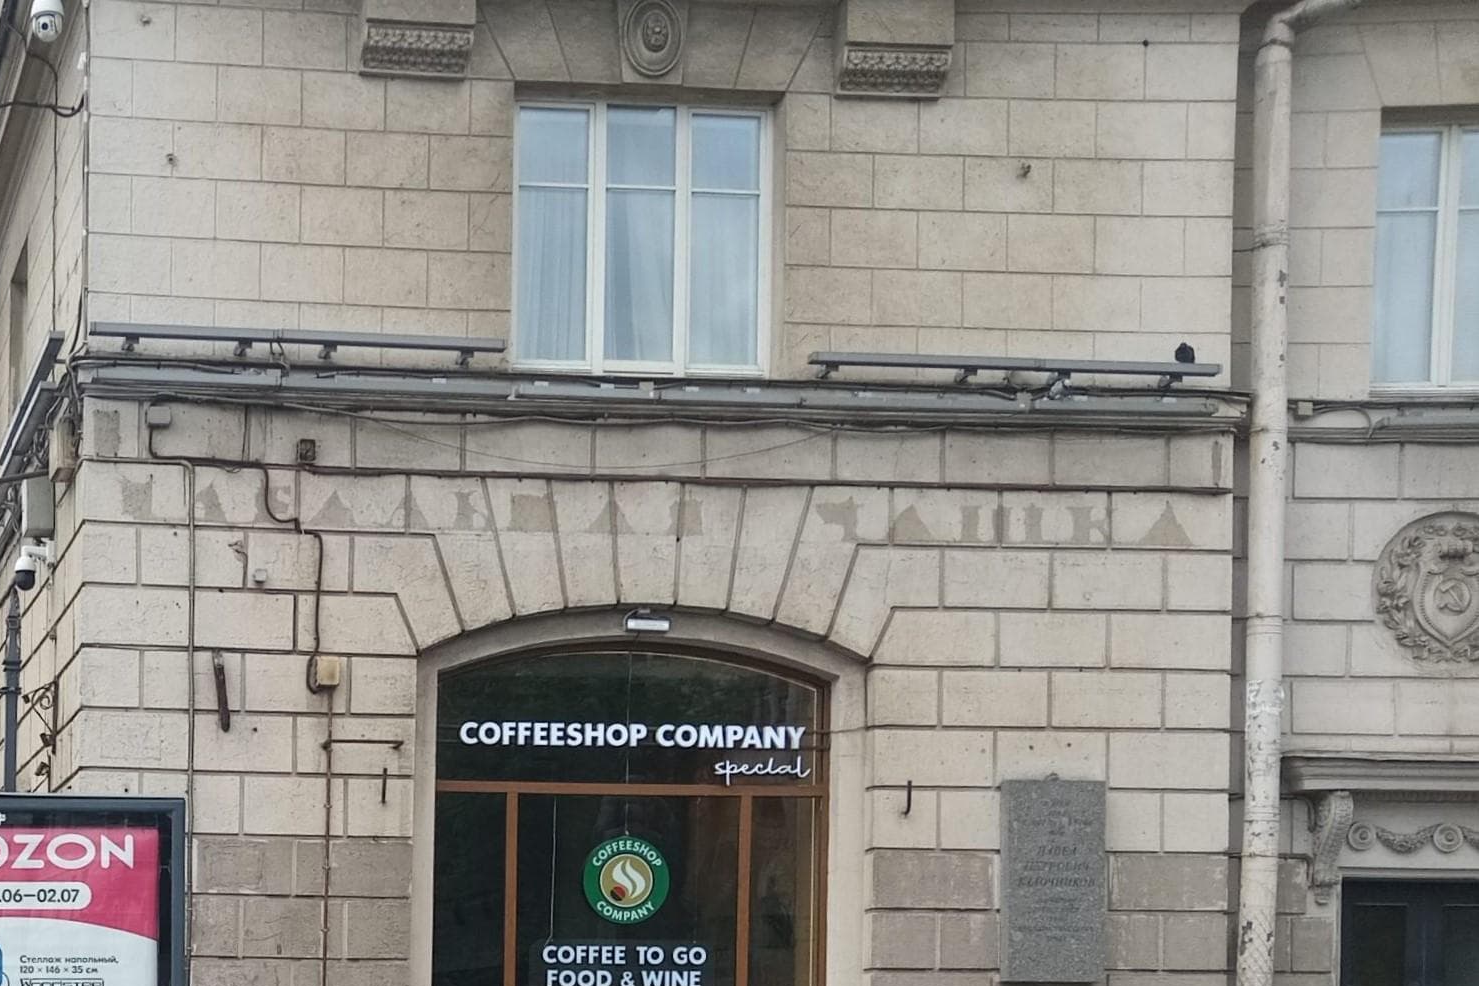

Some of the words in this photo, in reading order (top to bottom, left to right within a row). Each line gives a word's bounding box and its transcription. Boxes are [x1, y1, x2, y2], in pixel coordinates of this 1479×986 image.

[459, 720, 648, 748] COFFEESHOP
[655, 723, 807, 751] COMPANY
[713, 755, 812, 786] special
[591, 839, 663, 868] COFFEESHOP
[596, 899, 656, 922] COMPANY
[20, 955, 62, 964] Стеллаж
[542, 945, 626, 966] COFFEE
[636, 946, 665, 965] TO
[672, 946, 707, 965] GO
[20, 966, 35, 974] 120
[46, 966, 61, 974] 146
[72, 966, 83, 974] 35
